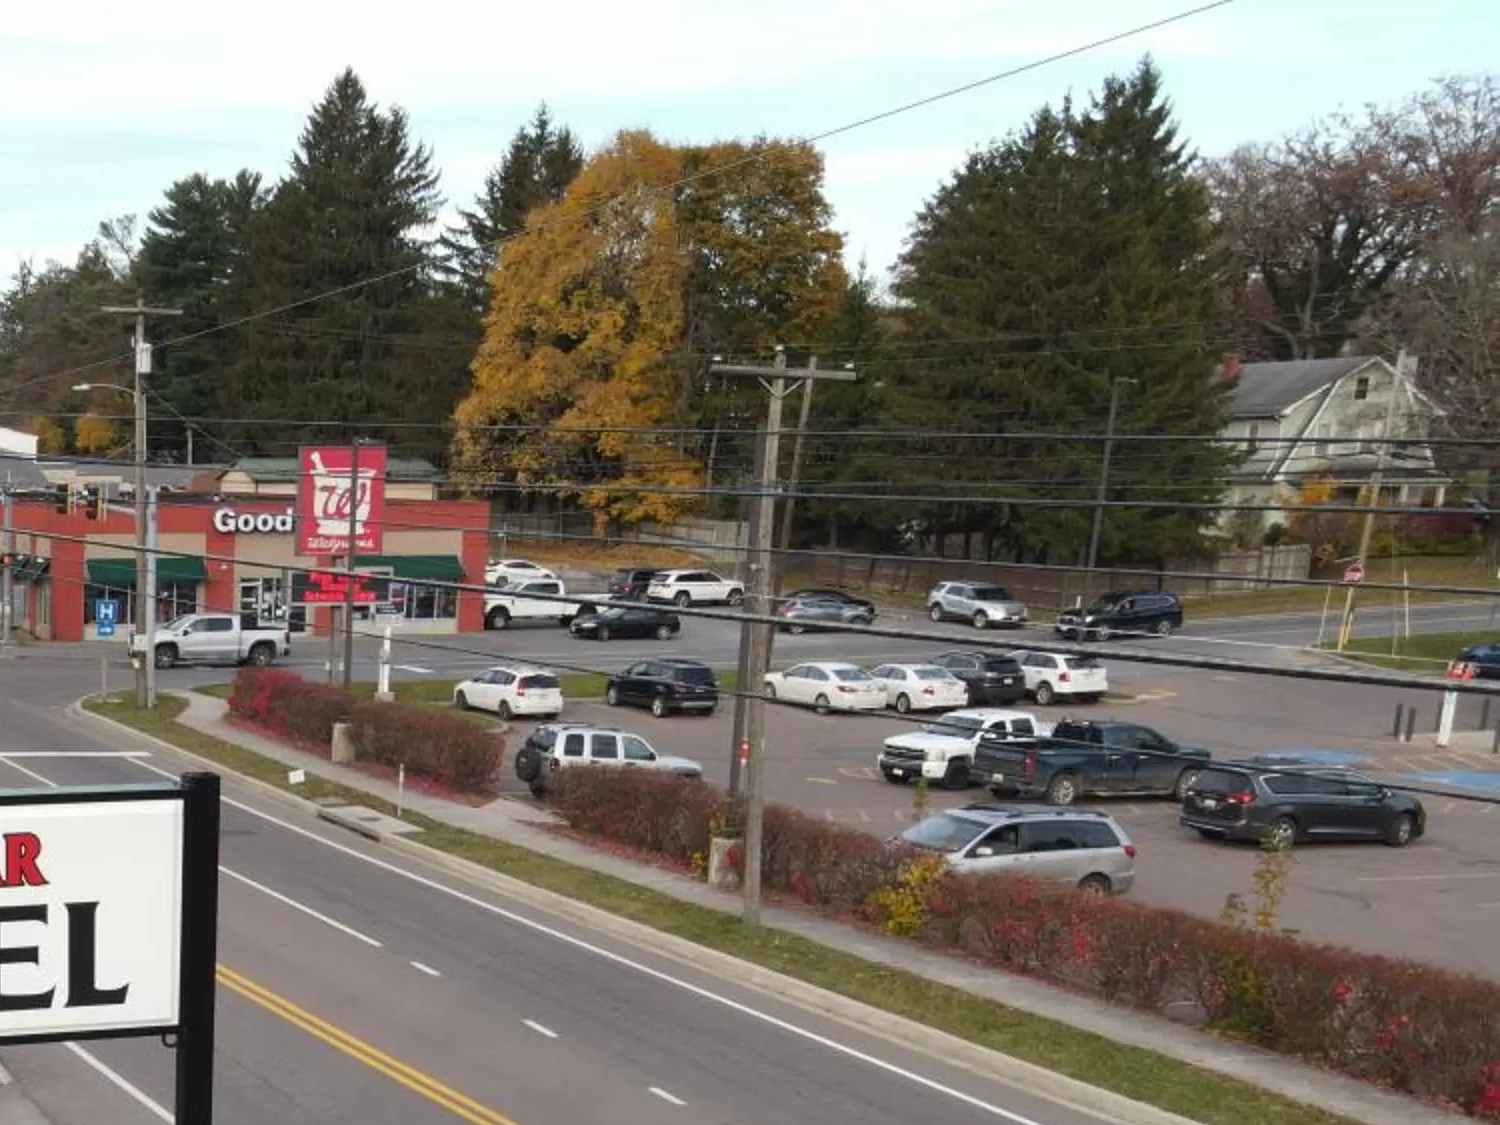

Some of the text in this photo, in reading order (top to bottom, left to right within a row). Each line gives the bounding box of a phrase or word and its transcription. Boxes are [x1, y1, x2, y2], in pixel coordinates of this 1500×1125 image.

[214, 507, 294, 533] Good
[307, 537, 375, 553] Walgrens
[100, 603, 114, 619] H
